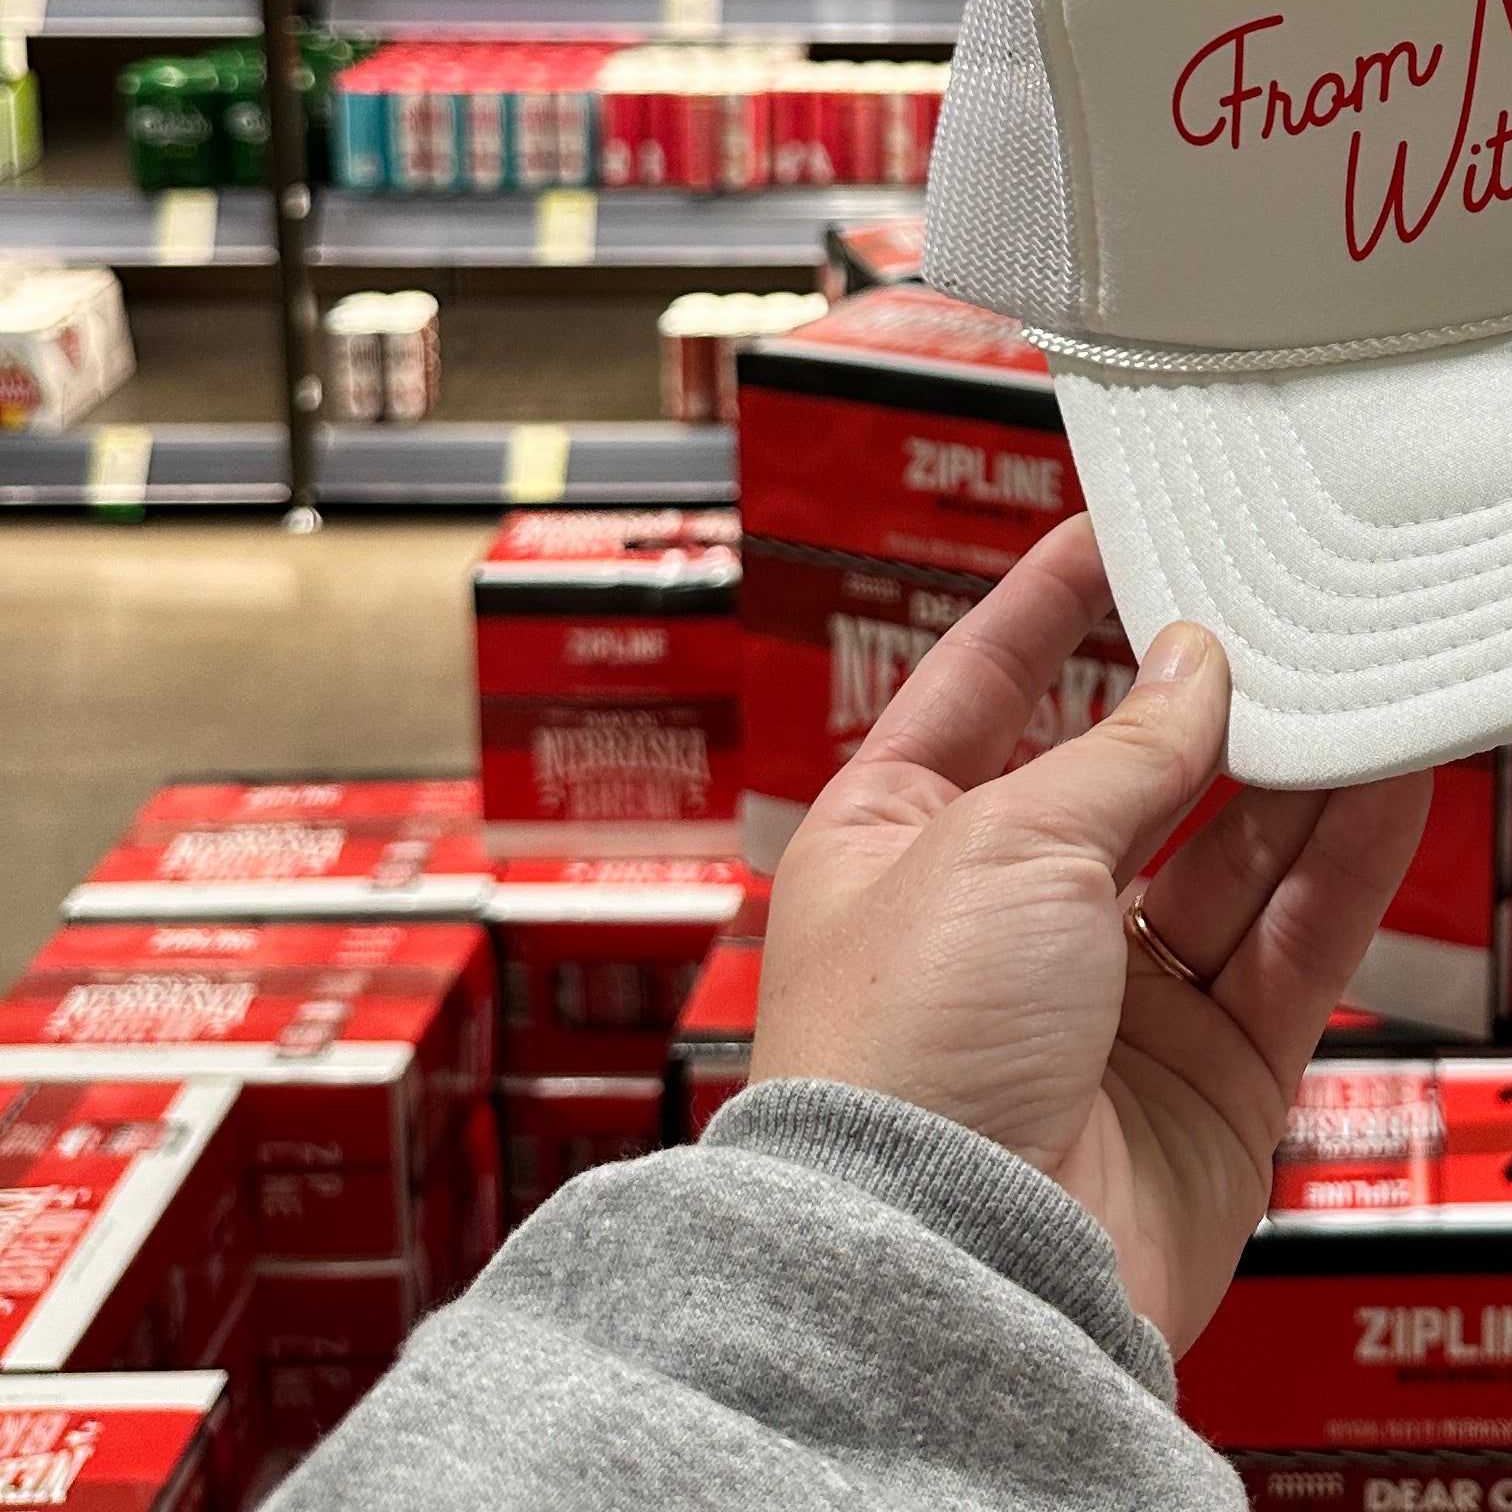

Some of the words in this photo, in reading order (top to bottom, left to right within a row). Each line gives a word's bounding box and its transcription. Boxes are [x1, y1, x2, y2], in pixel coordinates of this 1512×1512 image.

[1173, 15, 1444, 150] From
[905, 435, 1063, 510] ZIPLINE
[1365, 1478, 1479, 1512] DEAR
